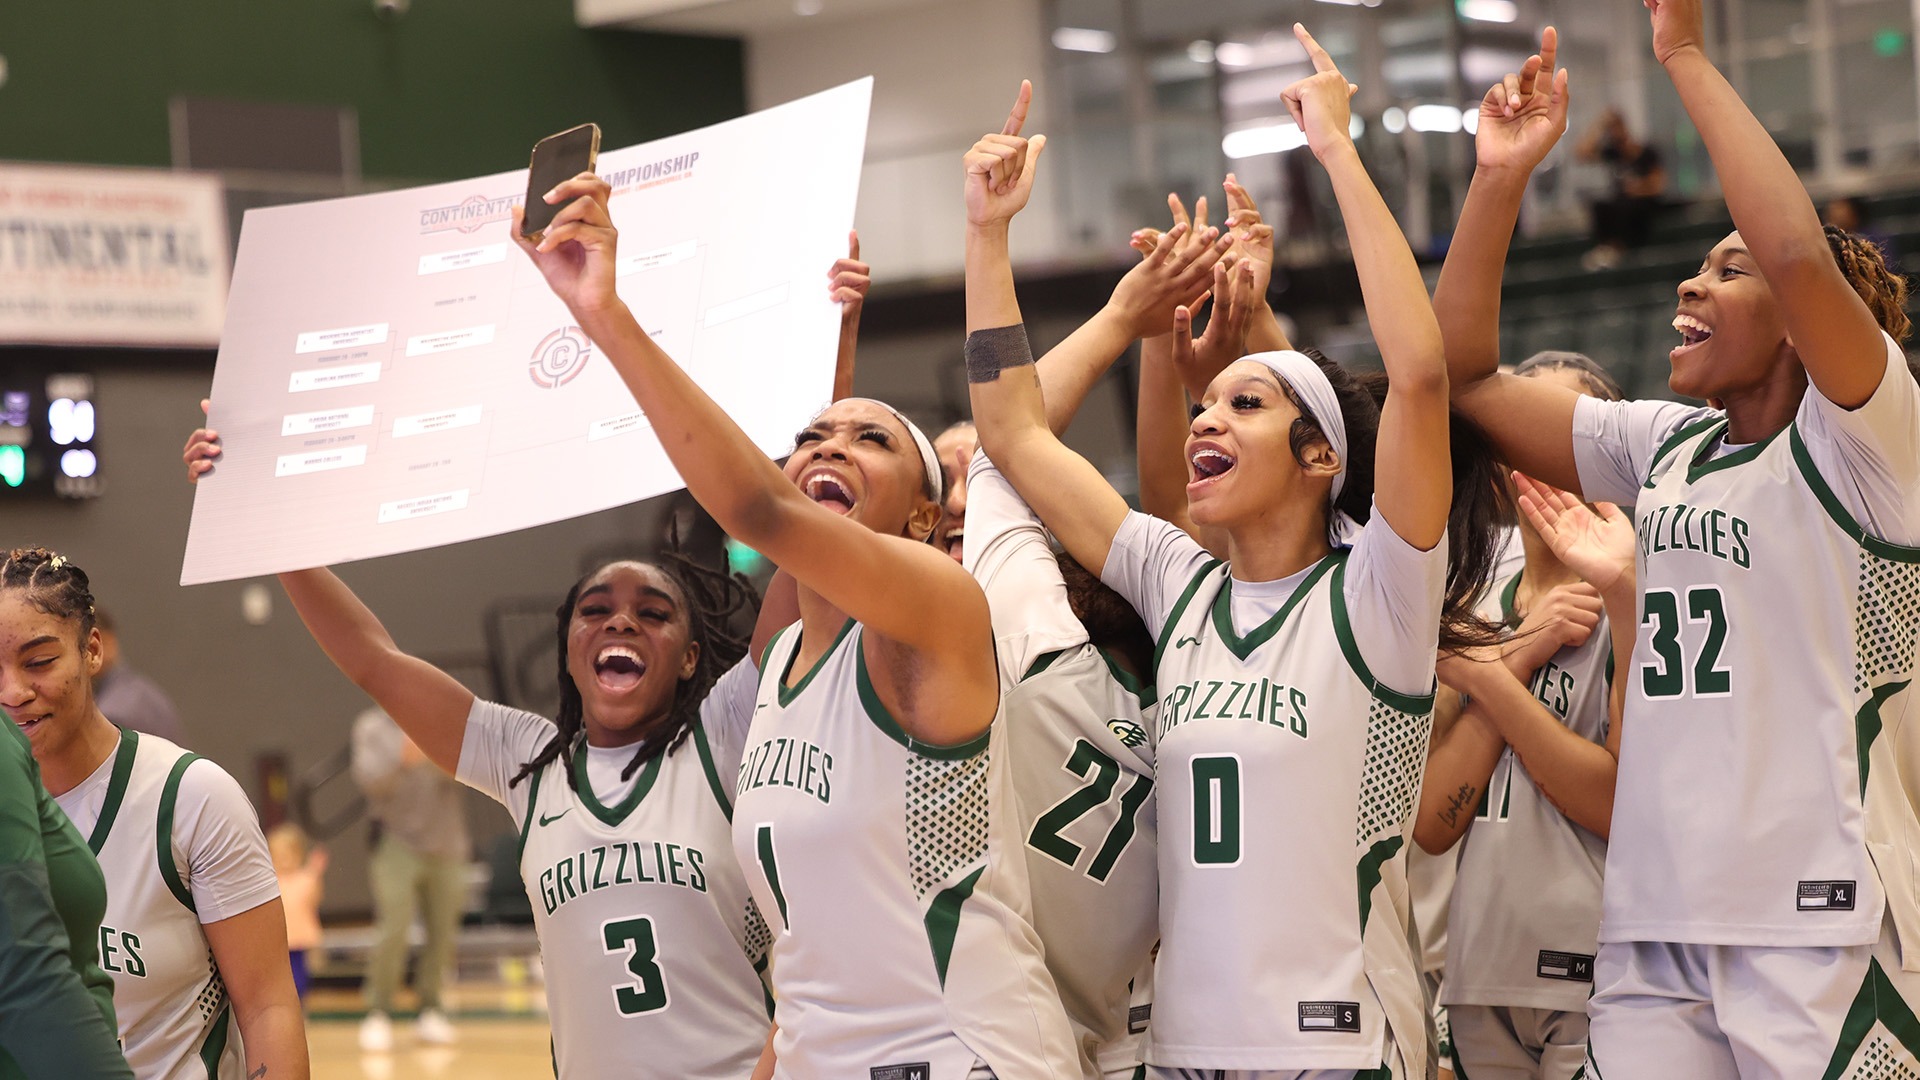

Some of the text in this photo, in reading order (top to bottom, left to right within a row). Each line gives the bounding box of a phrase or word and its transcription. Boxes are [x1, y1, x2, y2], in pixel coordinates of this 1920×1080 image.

[600, 152, 699, 187] AMPIONSHIP
[551, 345, 570, 369] C
[1638, 503, 1751, 579] RIZZLIES
[1640, 584, 1732, 700] 32
[1158, 677, 1308, 746] GRIZZLIES
[736, 738, 833, 805] RIZZLIES
[1024, 736, 1155, 886] 21
[1189, 753, 1244, 868] 0
[539, 841, 708, 918] GRIZZLIES
[755, 823, 791, 936] 1
[1835, 889, 1847, 901] XL
[600, 914, 671, 1018] 3
[1575, 962, 1586, 974] M
[1344, 1011, 1352, 1023] S
[910, 1071, 921, 1080] M
